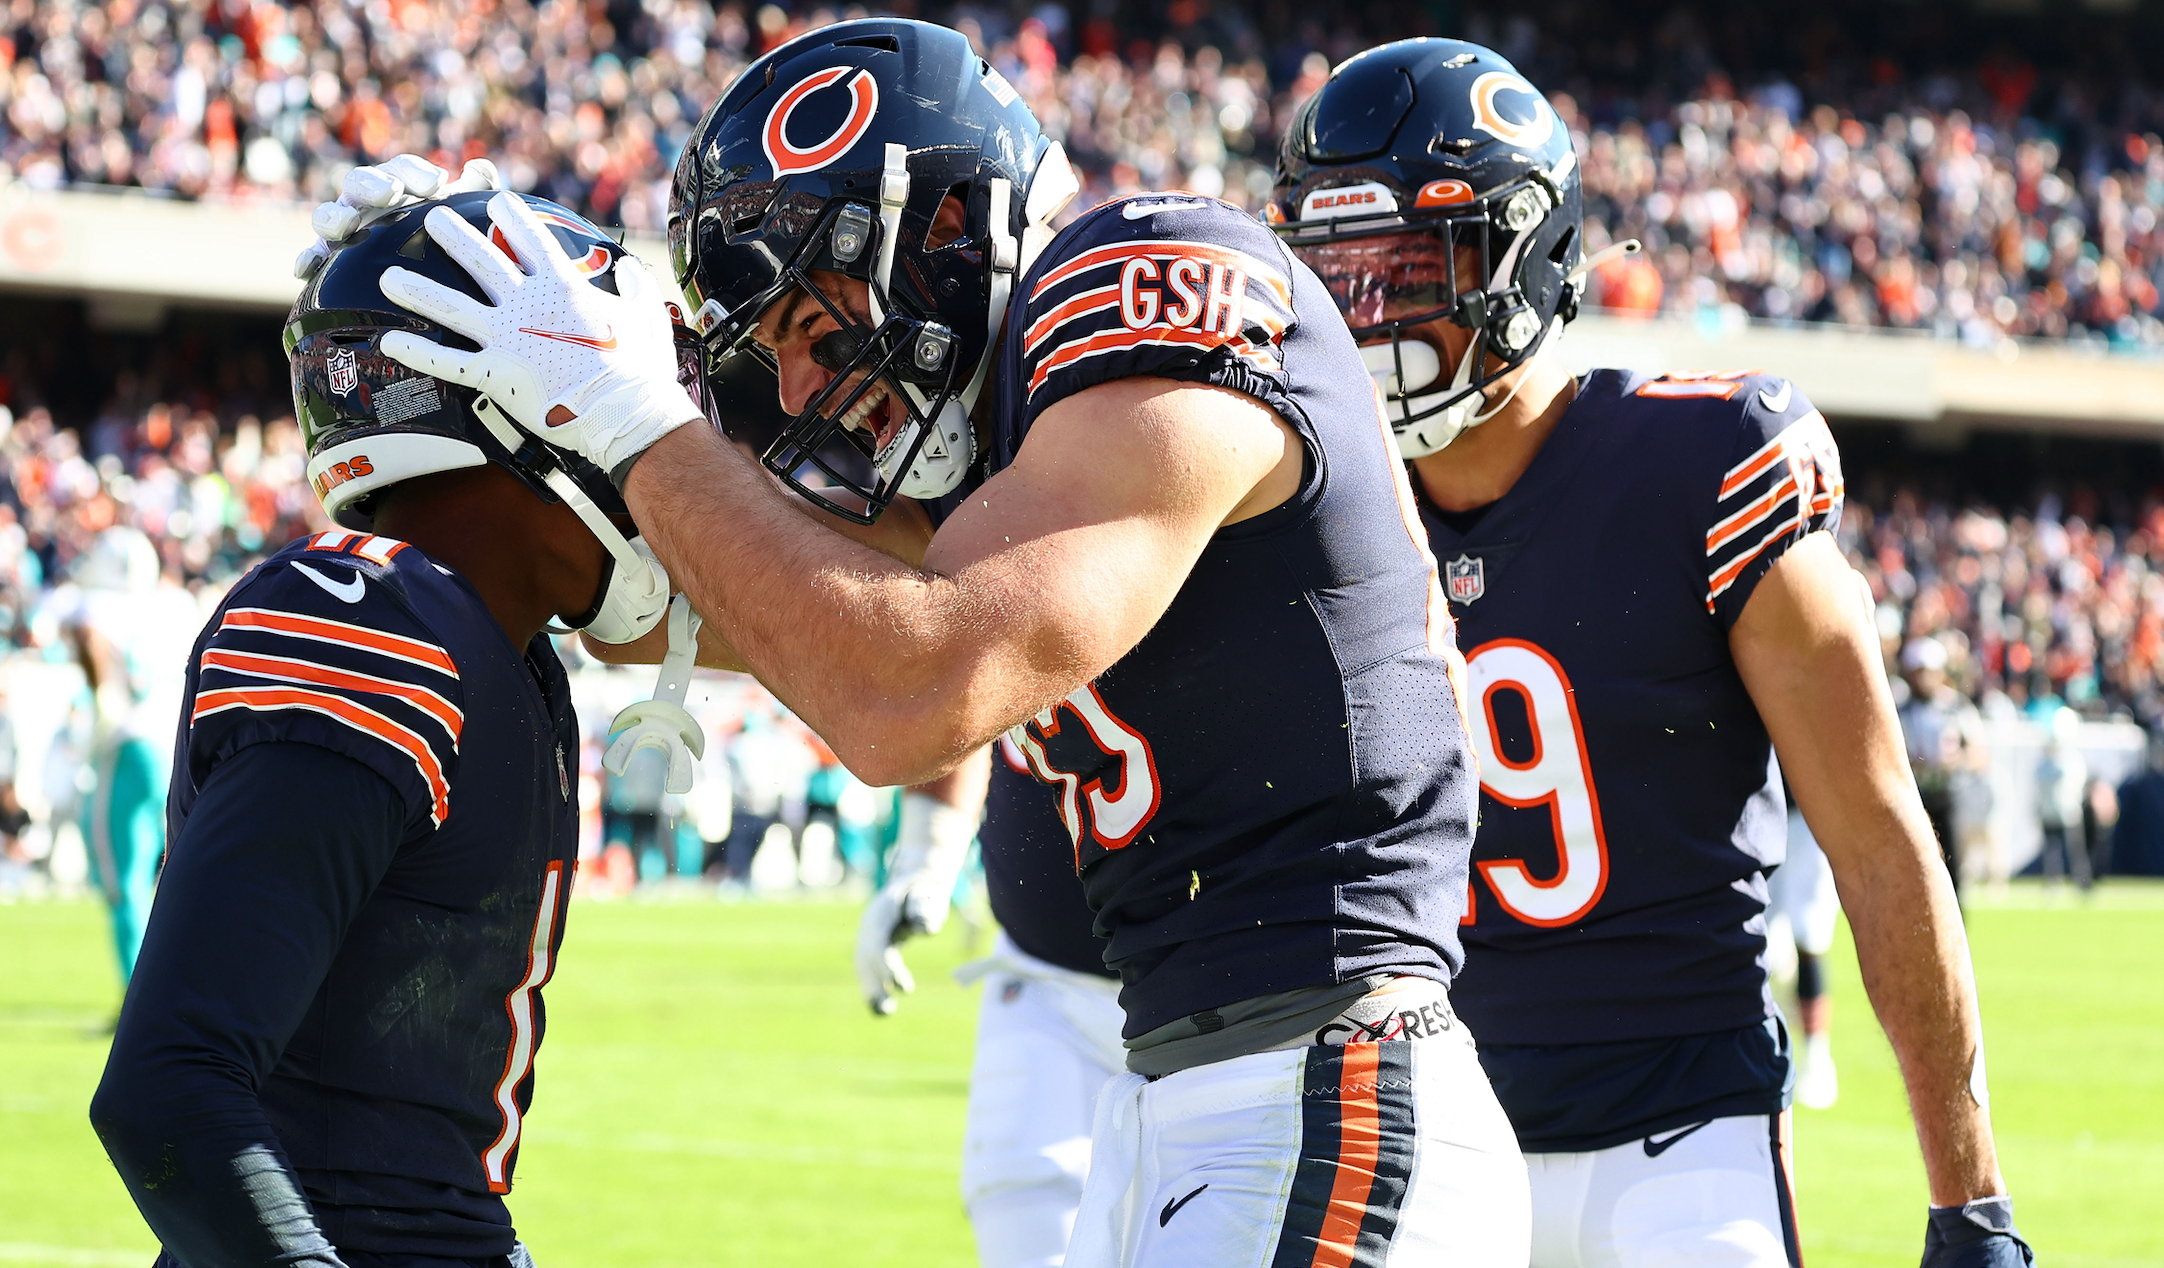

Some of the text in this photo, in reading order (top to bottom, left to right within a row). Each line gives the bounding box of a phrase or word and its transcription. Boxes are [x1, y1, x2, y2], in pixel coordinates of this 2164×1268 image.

[762, 66, 879, 181] C
[1470, 71, 1553, 148] C
[1312, 191, 1377, 210] BEARS
[1120, 256, 1247, 338] GSH
[332, 369, 354, 390] NFL
[314, 455, 375, 503] EARS
[1453, 577, 1480, 596] NFL
[1460, 637, 1610, 928] 9
